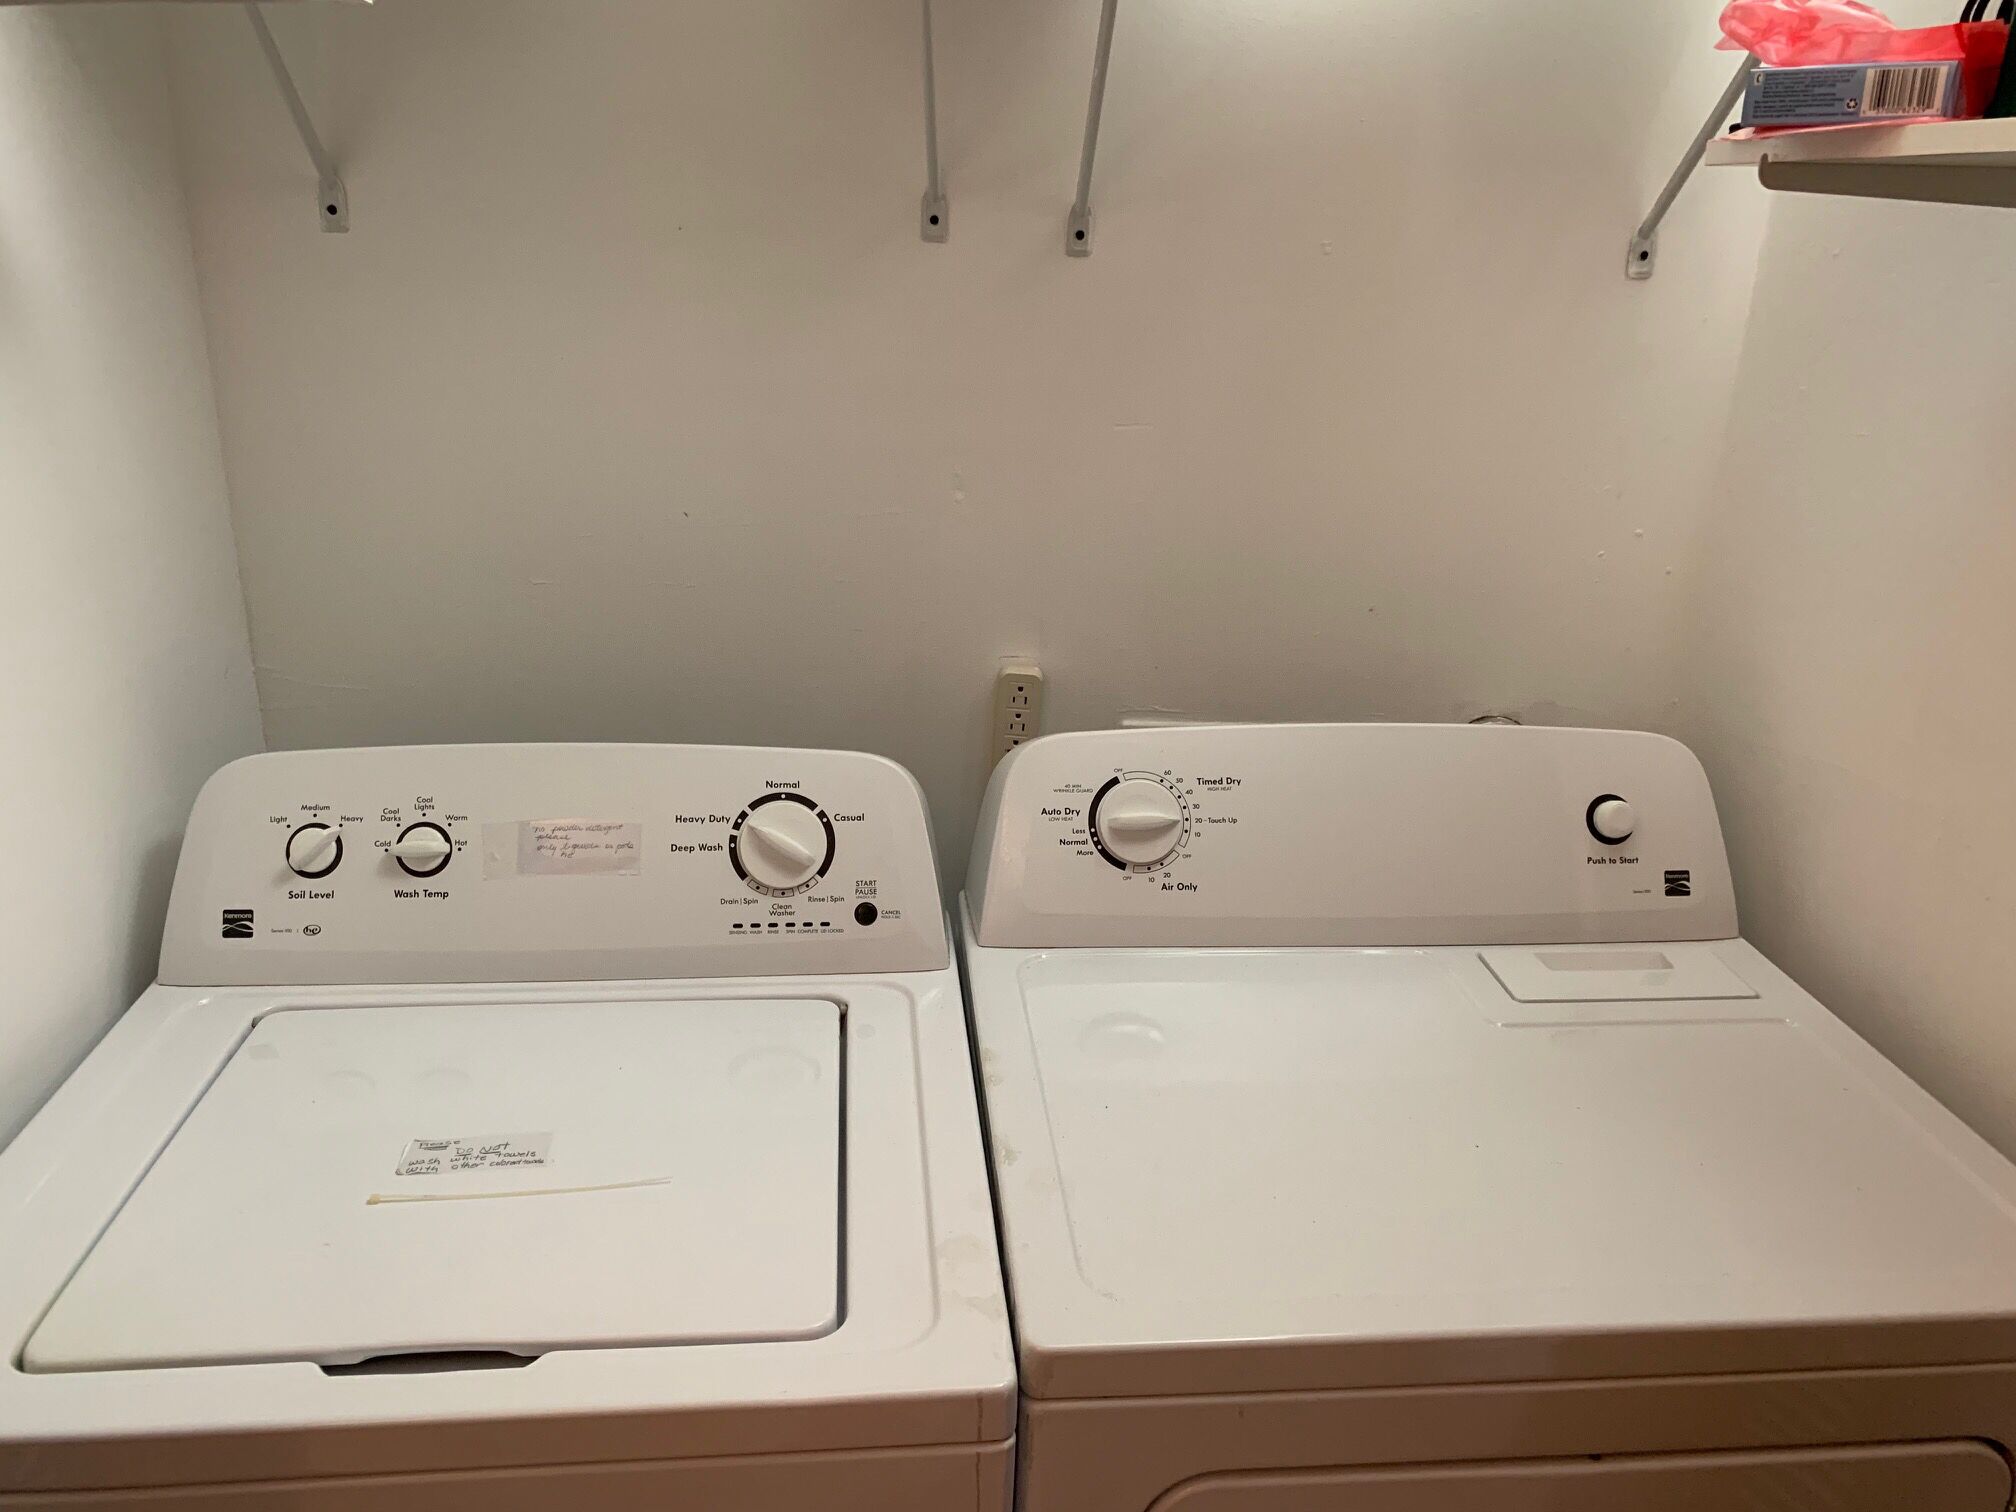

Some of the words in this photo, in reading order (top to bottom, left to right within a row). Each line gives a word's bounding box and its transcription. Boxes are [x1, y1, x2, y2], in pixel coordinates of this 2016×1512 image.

[765, 780, 800, 788] Normal
[1197, 778, 1223, 786] Timed
[1226, 778, 1241, 787] Dry
[414, 803, 435, 812] Lights
[1065, 808, 1081, 816] Dry
[341, 815, 363, 823] Heavy
[675, 815, 705, 824] Heavy
[709, 815, 731, 824] Duty
[834, 813, 865, 822] Casual
[552, 824, 583, 834] powder
[586, 824, 623, 835] detergent
[670, 844, 695, 853] Deep
[698, 843, 723, 852] Wash
[1177, 883, 1197, 892] Only
[288, 891, 306, 899] Soil
[309, 891, 334, 899] Level
[394, 890, 419, 898] Wash
[423, 890, 449, 899] Temp
[451, 1161, 484, 1170] other
